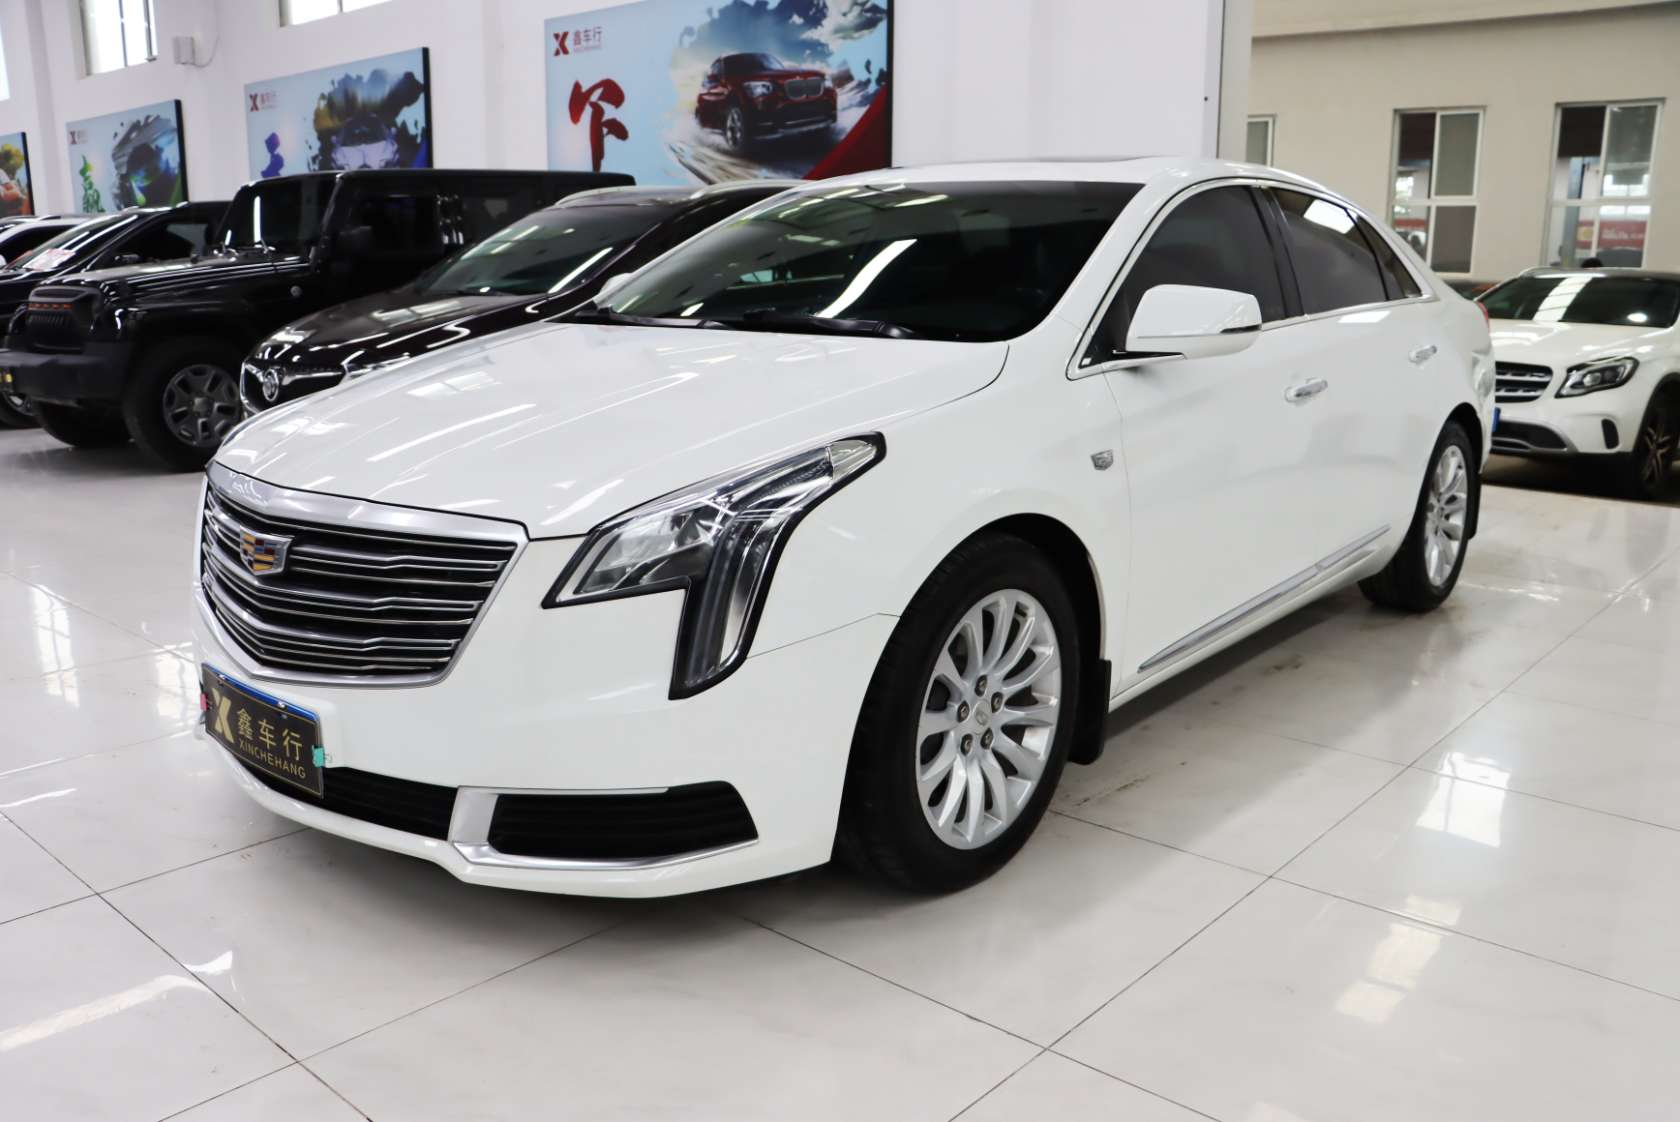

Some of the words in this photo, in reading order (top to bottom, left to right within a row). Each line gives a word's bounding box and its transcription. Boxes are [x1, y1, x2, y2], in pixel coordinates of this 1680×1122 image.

[236, 708, 302, 761] 鑫车行
[238, 737, 306, 779] XINCHEHANG
